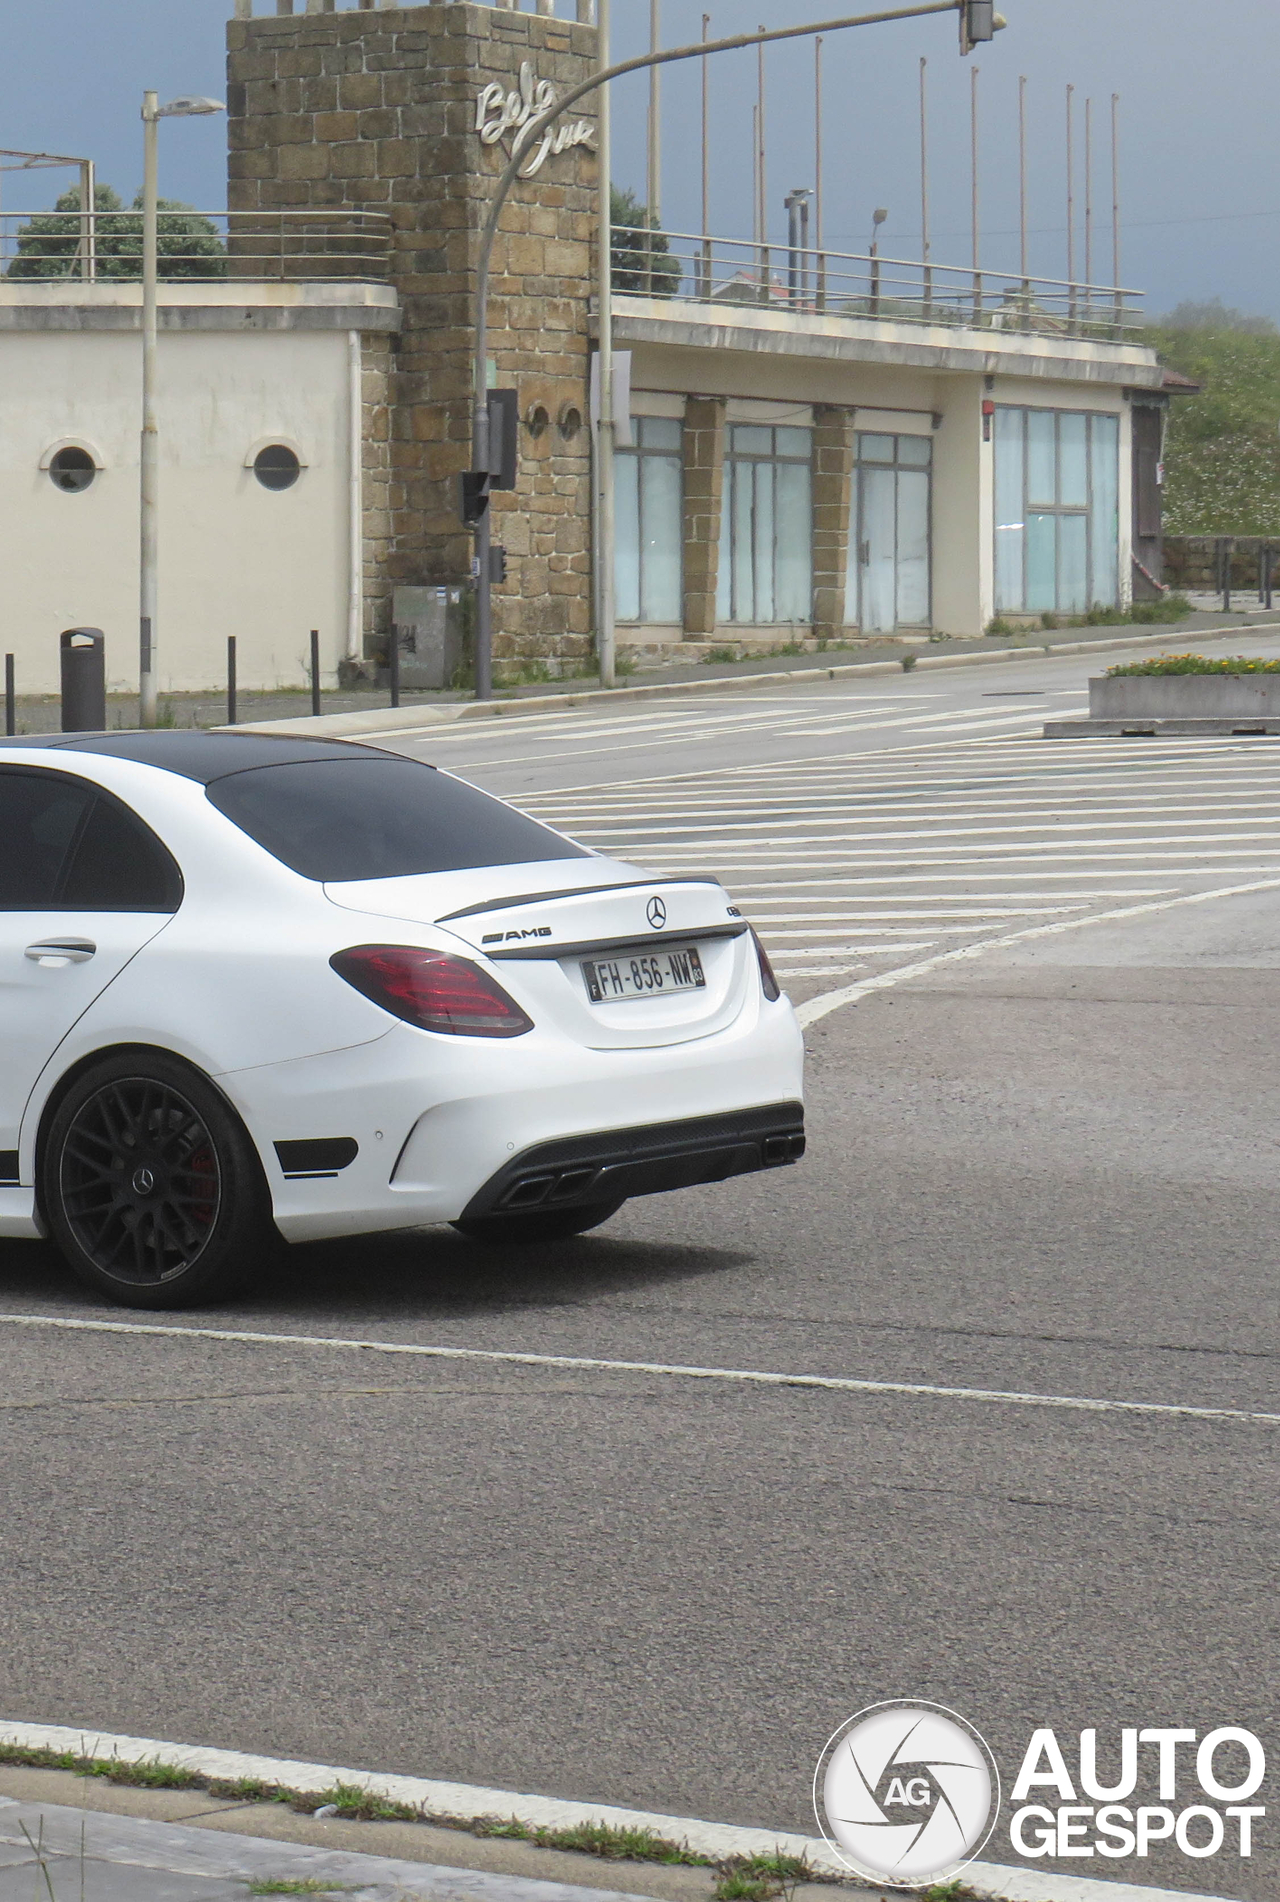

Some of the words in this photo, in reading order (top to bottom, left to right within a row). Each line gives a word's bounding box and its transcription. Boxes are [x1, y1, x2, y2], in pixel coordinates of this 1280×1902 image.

[505, 926, 553, 941] AMG
[597, 953, 694, 996] FH-856-NW
[591, 984, 597, 996] F
